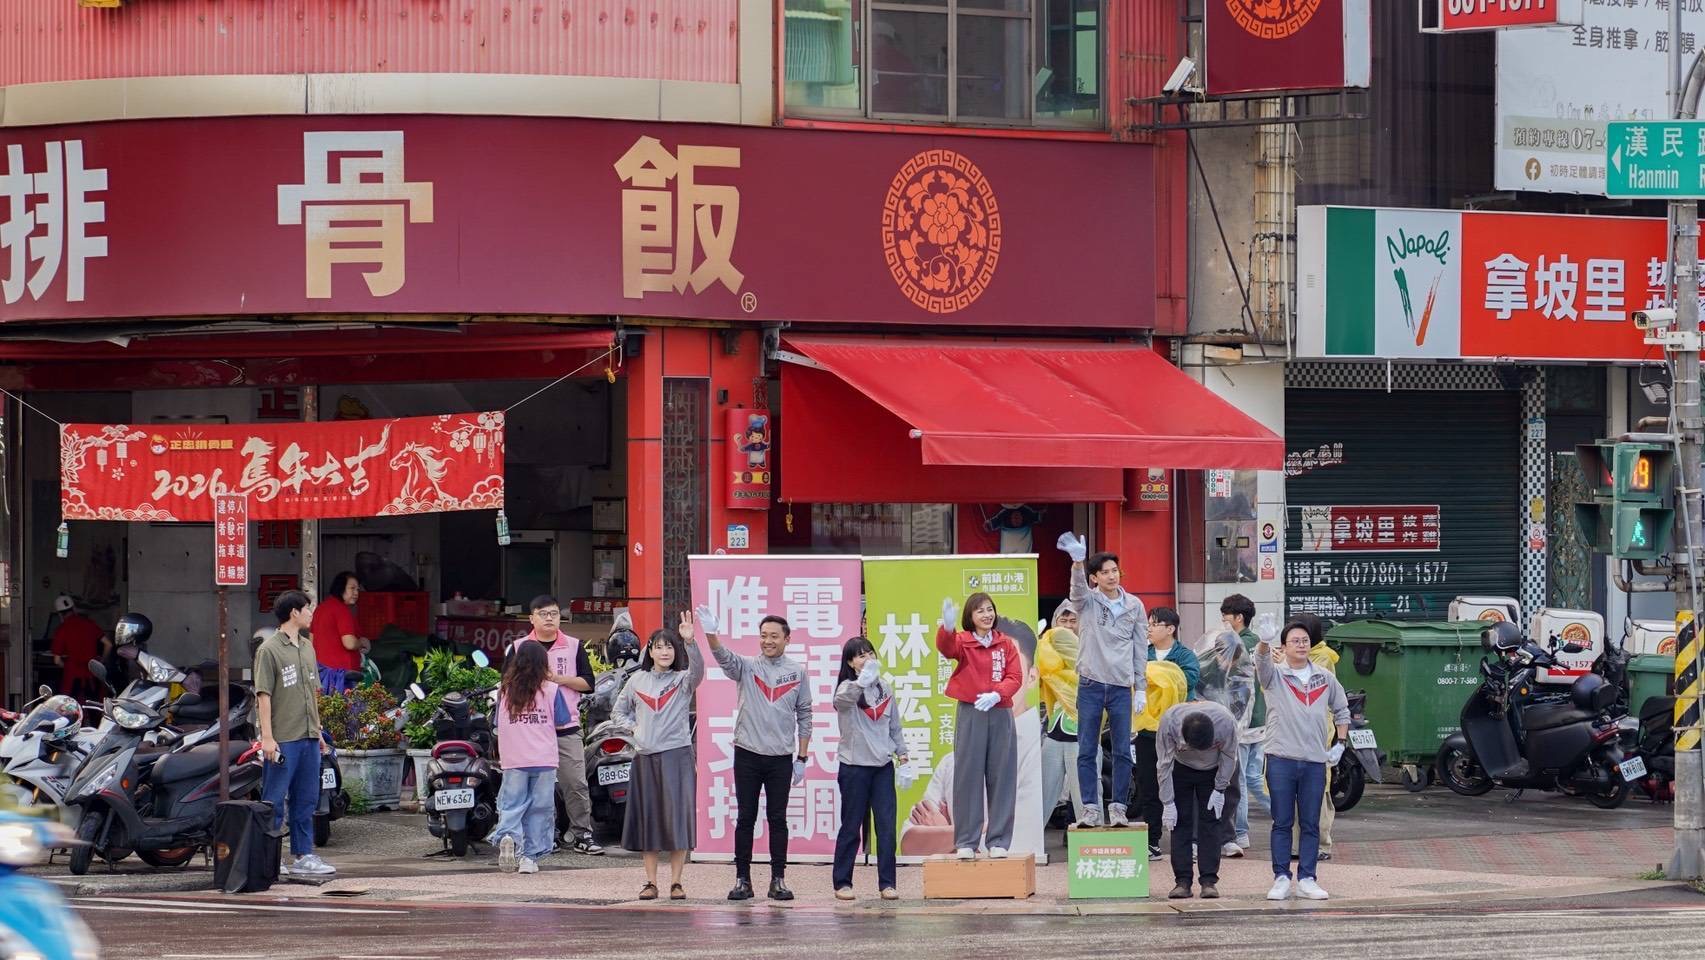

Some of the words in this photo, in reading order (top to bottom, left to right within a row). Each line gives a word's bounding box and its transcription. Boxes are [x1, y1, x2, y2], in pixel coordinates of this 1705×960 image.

[1513, 127, 1607, 150] 預約專線07-
[1629, 163, 1679, 189] Hanmin
[1387, 228, 1451, 265] Napoli
[1484, 253, 1626, 322] 拿坡里
[1531, 429, 1543, 438] 227
[151, 467, 228, 501] 2026
[730, 536, 746, 547] 223
[1333, 515, 1396, 544] 拿坡里
[599, 769, 630, 782] 289-GS
